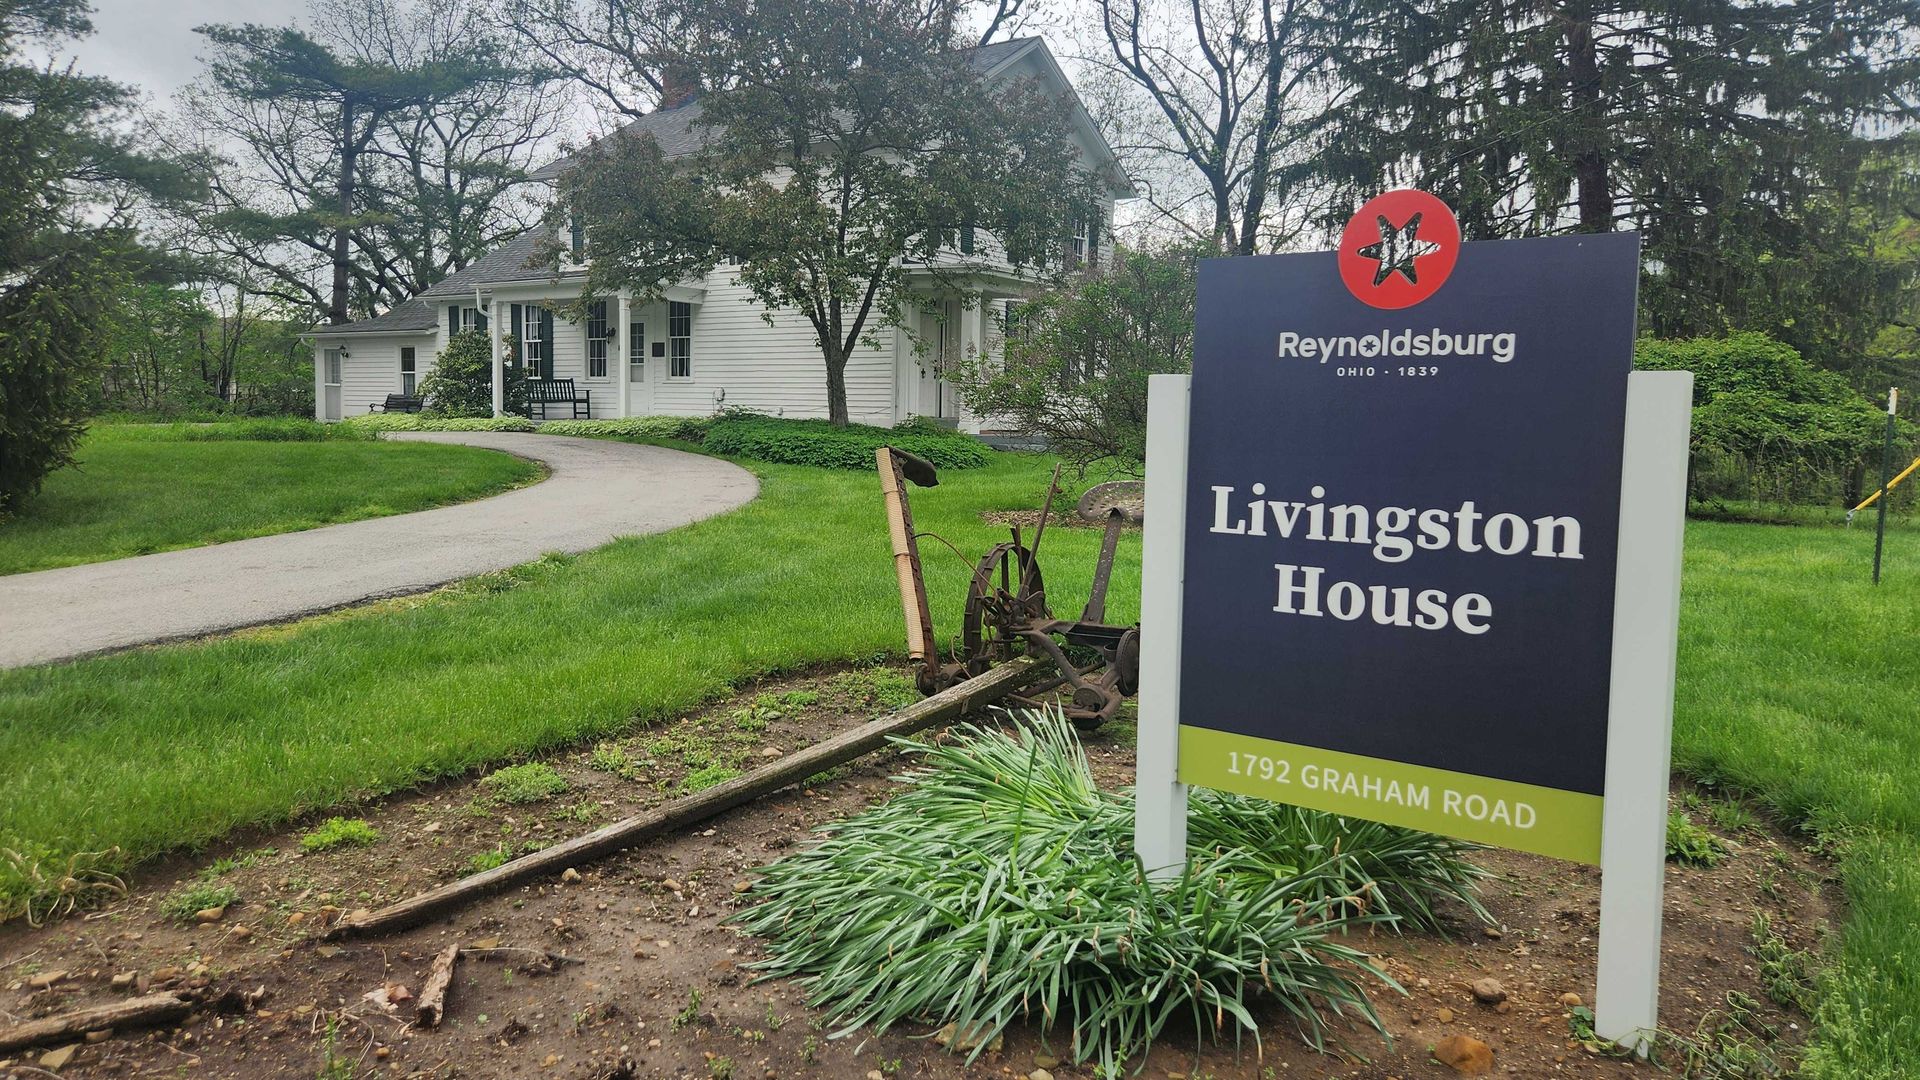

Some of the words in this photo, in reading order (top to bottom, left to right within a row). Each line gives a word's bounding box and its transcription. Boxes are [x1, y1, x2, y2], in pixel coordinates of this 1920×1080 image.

[1278, 328, 1516, 363] Reynoldsburg
[1336, 366, 1376, 377] OHIO
[1398, 366, 1439, 377] 1839
[1209, 482, 1584, 563] Livingston
[1272, 563, 1493, 635] House
[1227, 751, 1291, 784] 1792
[1300, 764, 1431, 811] GRAHAM
[1442, 789, 1537, 829] ROAD
